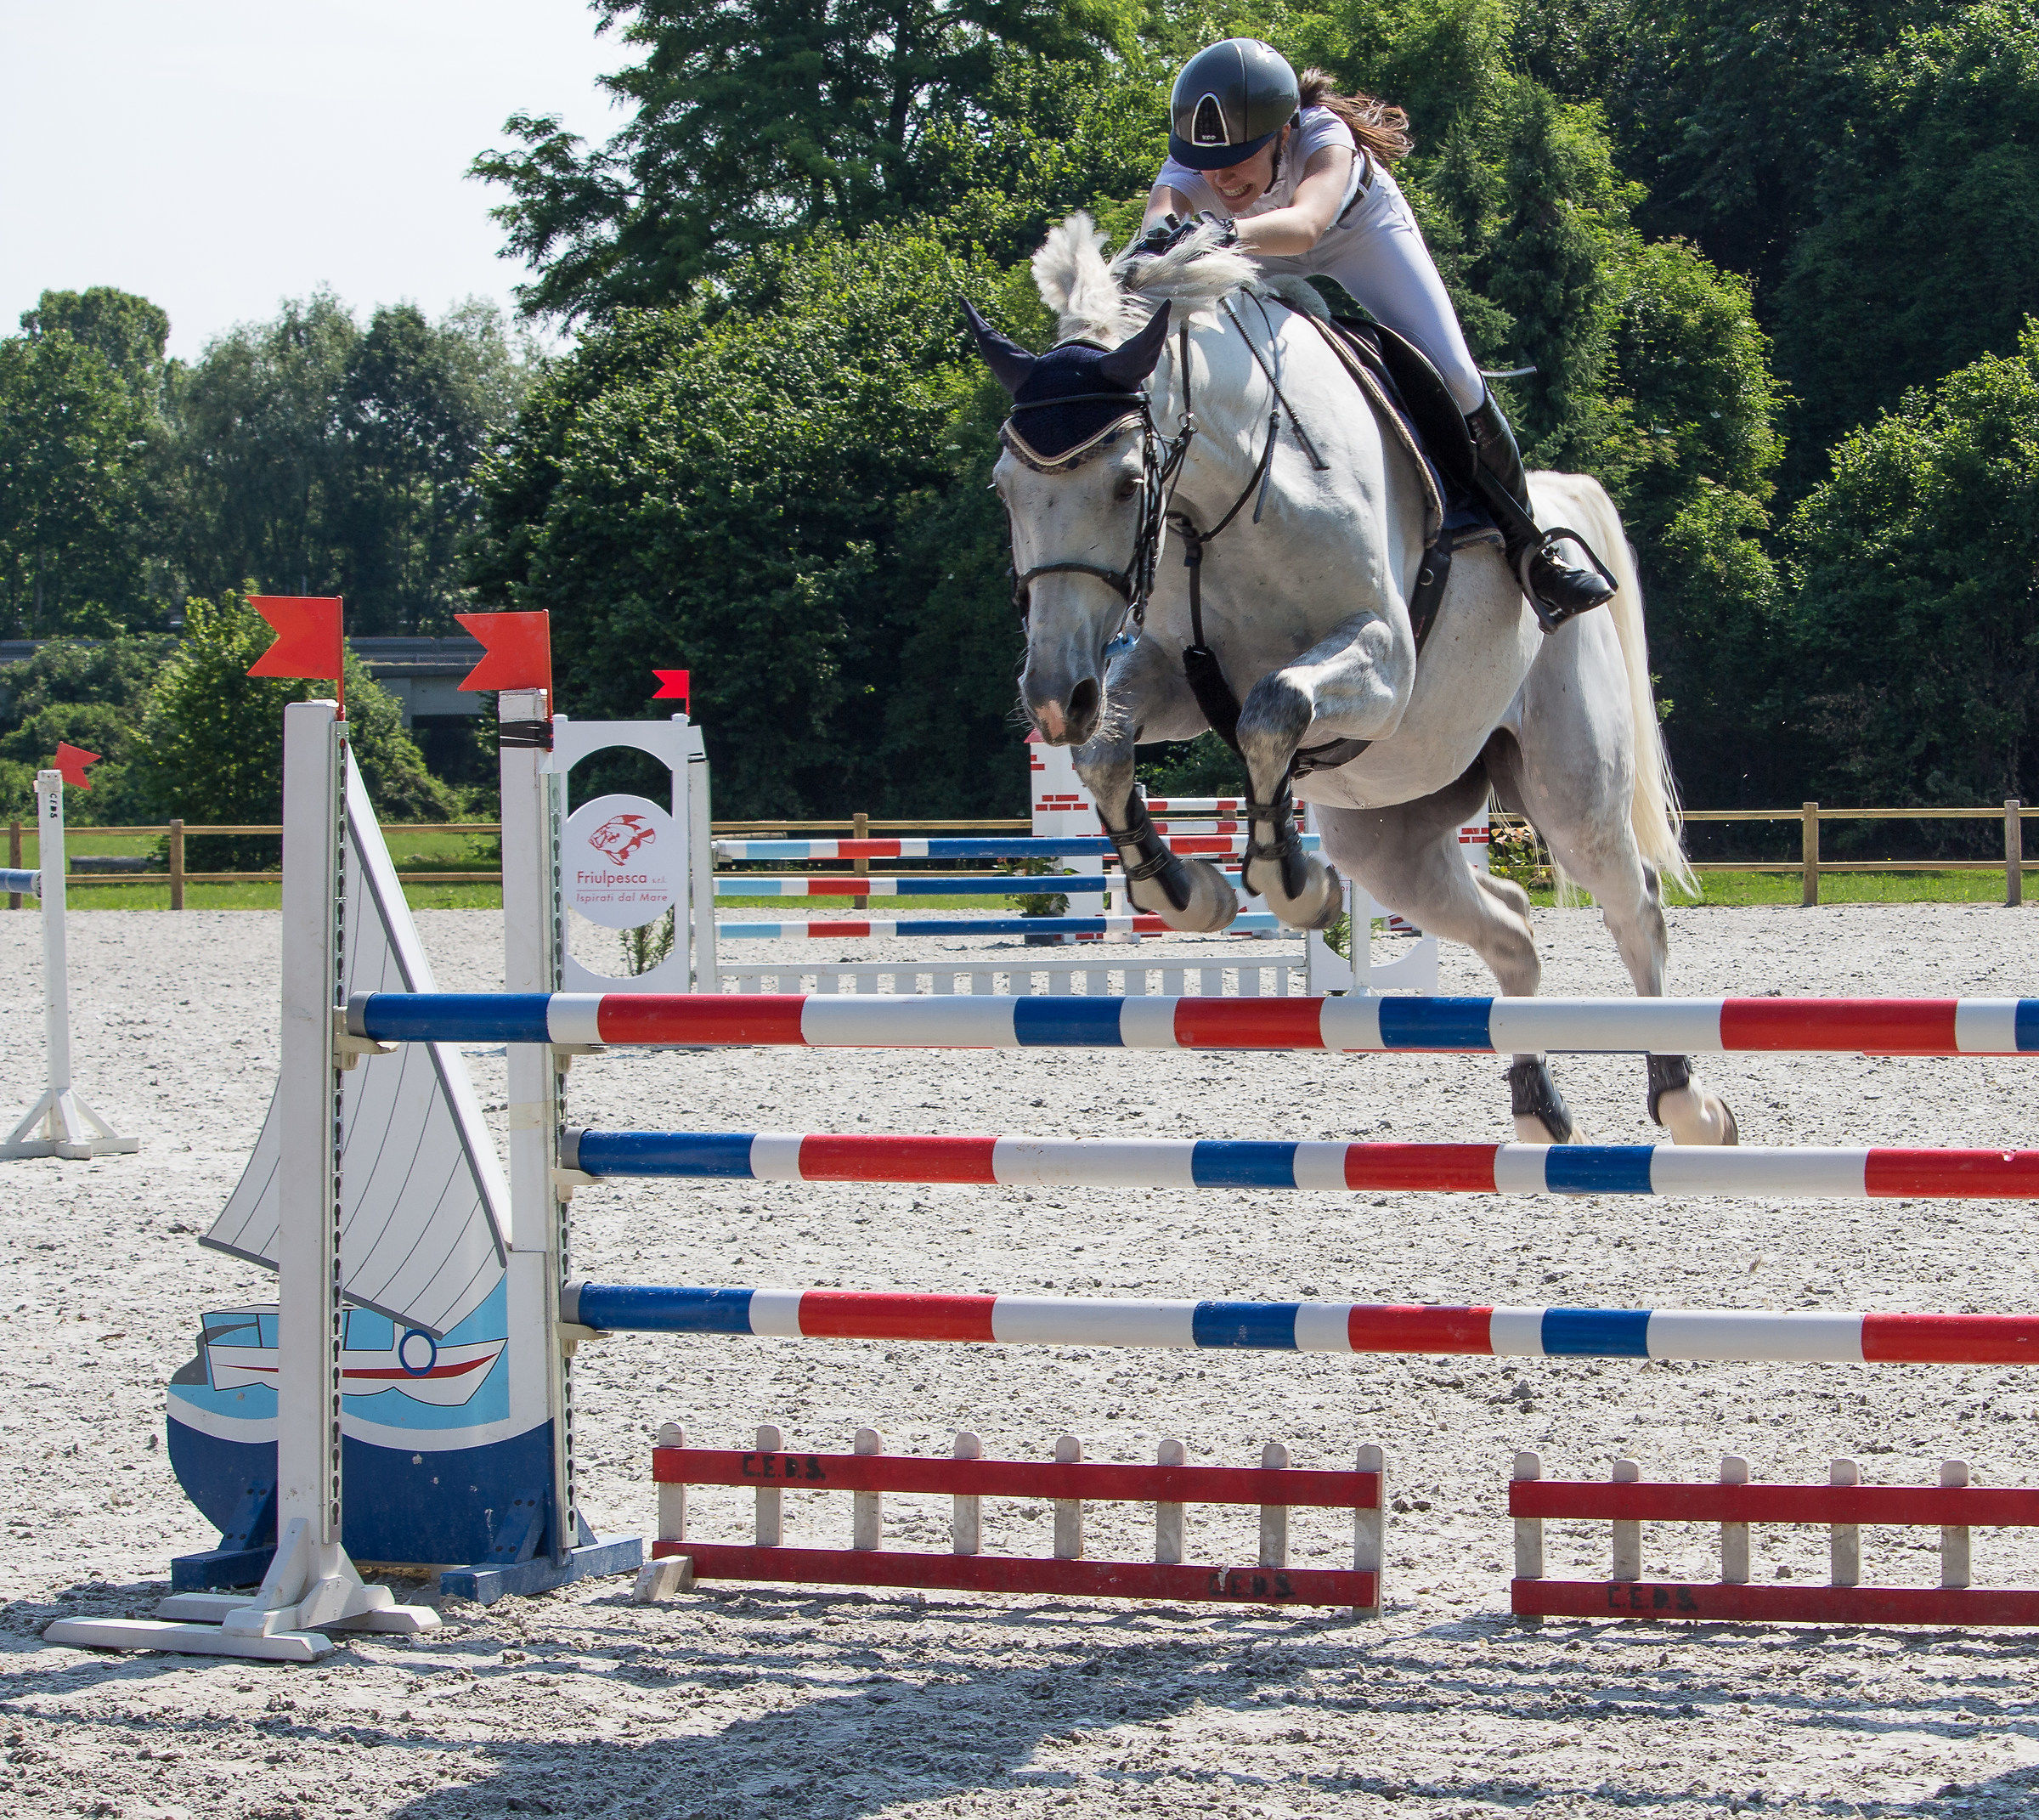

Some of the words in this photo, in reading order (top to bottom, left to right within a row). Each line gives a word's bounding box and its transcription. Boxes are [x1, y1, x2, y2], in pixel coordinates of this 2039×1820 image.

[577, 870, 647, 887] Friulpesca
[576, 893, 613, 904] Ispirati
[618, 892, 635, 902] dal
[639, 893, 668, 902] Mare
